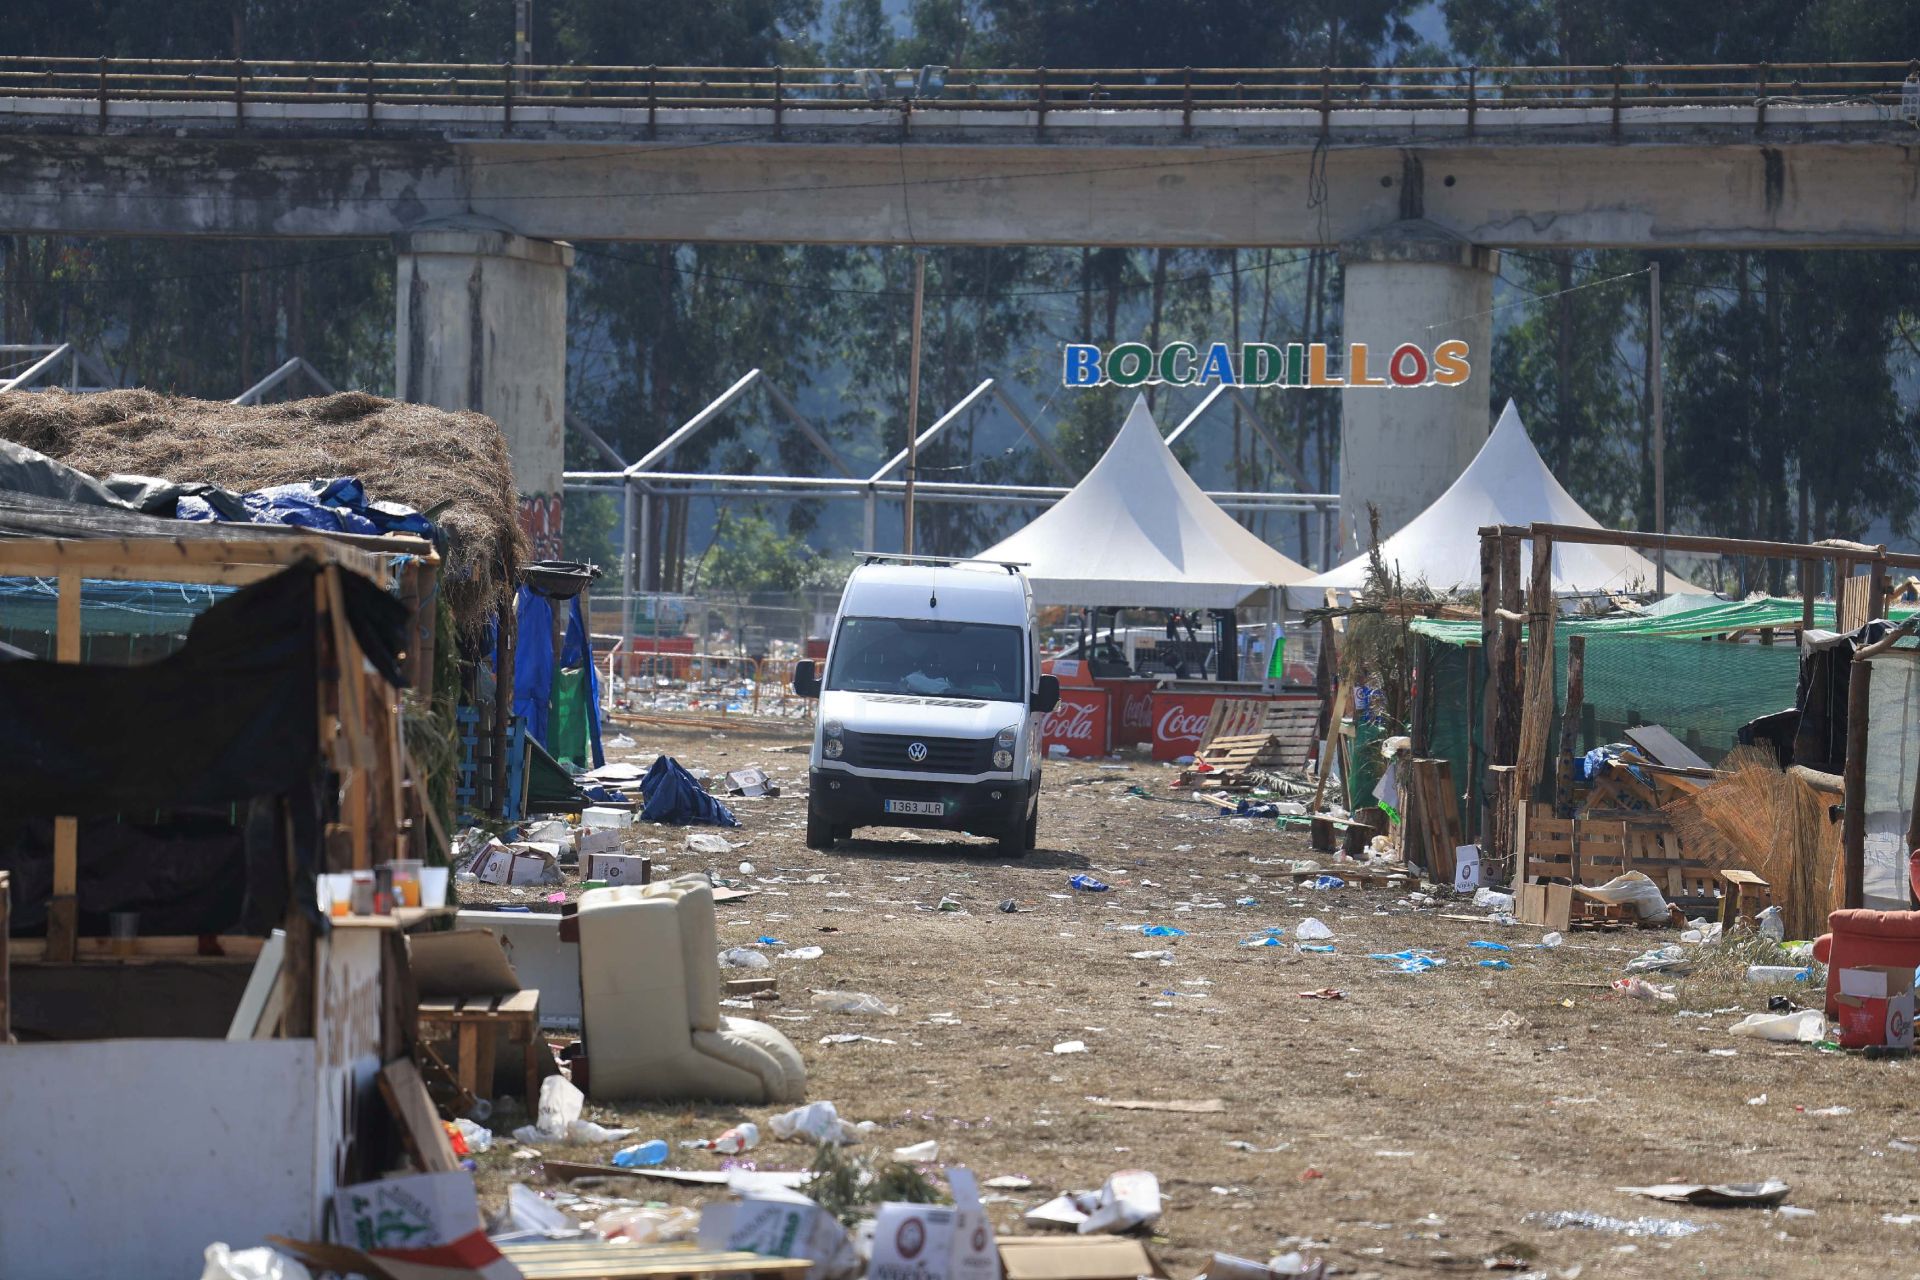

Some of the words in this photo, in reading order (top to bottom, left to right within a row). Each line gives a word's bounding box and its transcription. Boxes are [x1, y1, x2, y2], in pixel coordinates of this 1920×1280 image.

[1064, 340, 1471, 388] BOCADILLOS
[893, 801, 918, 813] 1363
[921, 803, 942, 814] JLR
